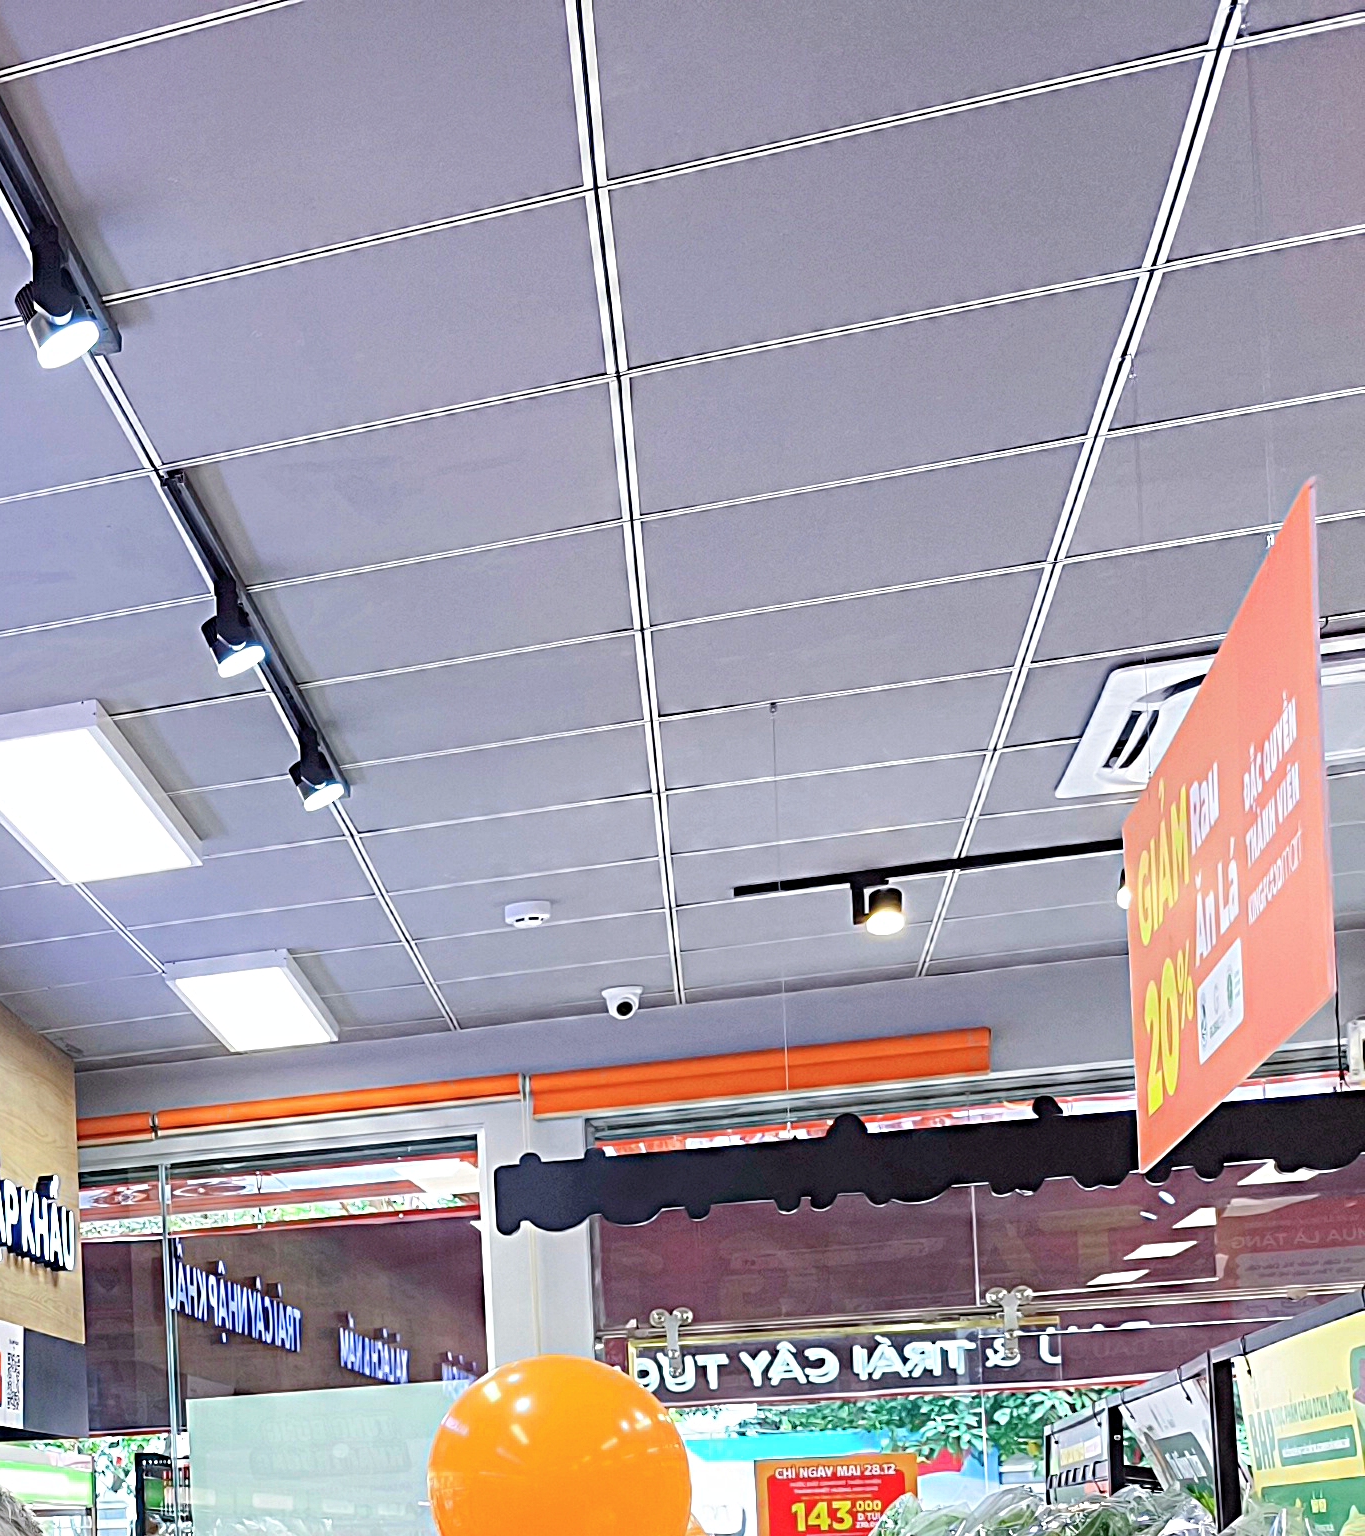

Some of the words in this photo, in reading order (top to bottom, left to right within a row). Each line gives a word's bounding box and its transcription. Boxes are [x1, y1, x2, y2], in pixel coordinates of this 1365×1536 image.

[1138, 777, 1189, 946] GIẢM
[1190, 761, 1219, 856] Rau
[1217, 837, 1239, 934] Lá
[1143, 940, 1195, 1118] 20%
[20, 1174, 76, 1271] KHẨU
[790, 1500, 853, 1532] 143
[836, 1464, 862, 1477] MAI
[863, 1463, 897, 1476] 28.12
